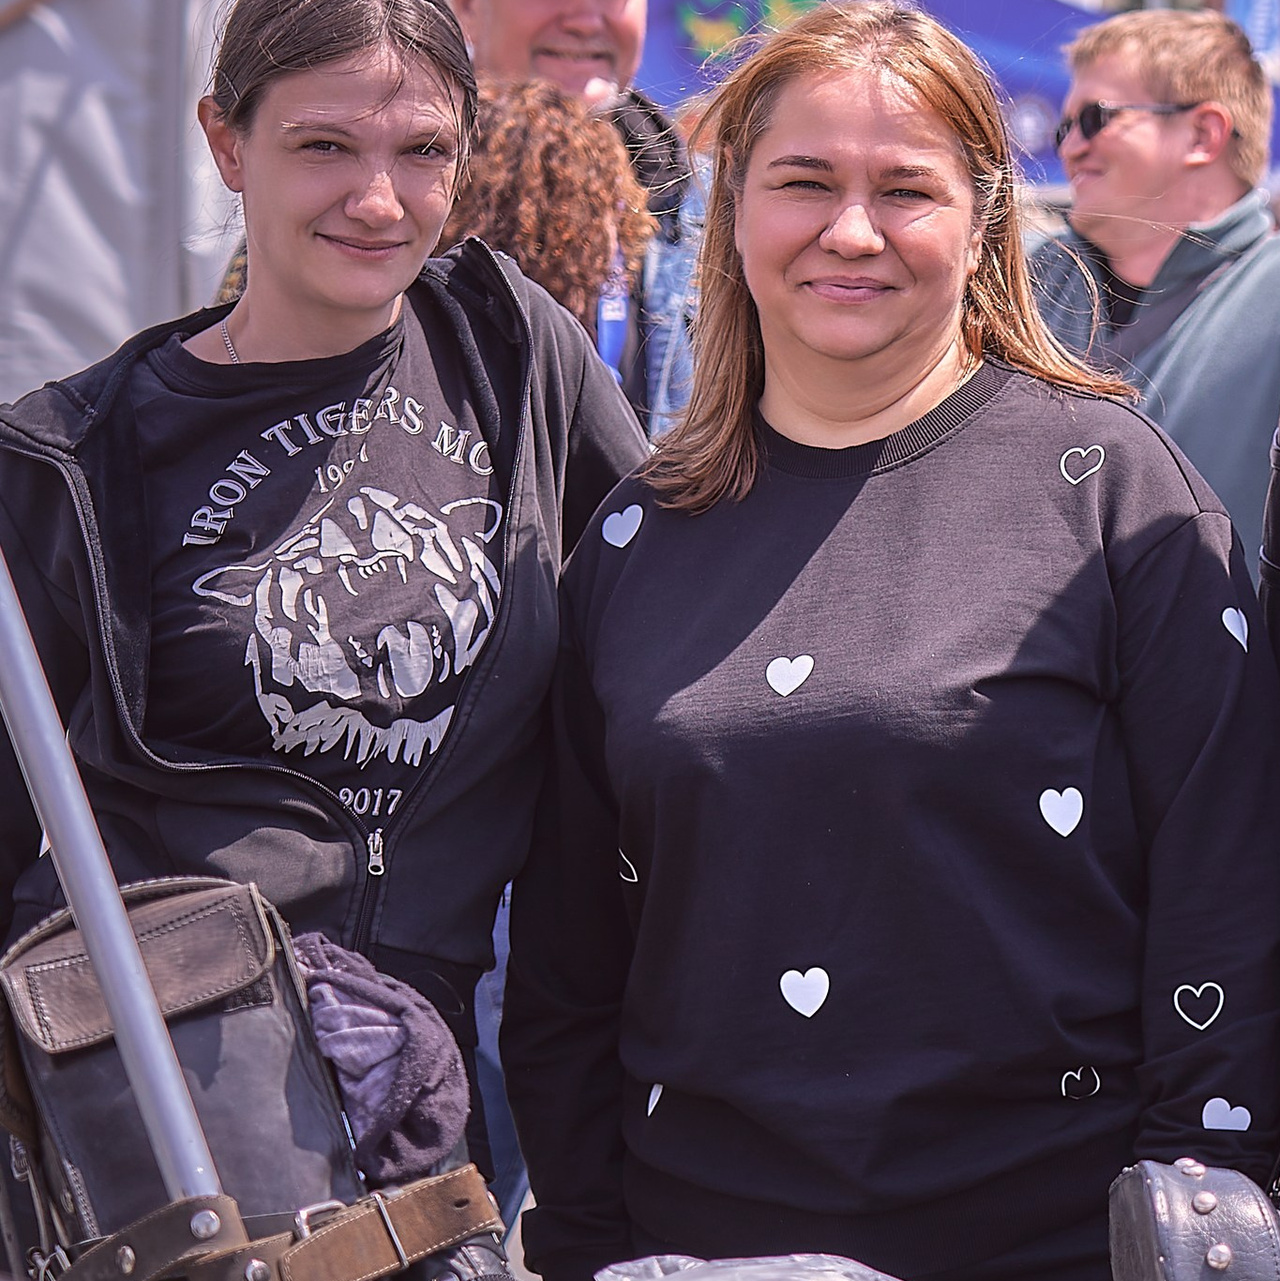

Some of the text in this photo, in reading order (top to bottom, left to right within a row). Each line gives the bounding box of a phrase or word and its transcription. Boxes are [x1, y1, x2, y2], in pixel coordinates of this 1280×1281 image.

[182, 386, 495, 547] IRON TIGERS MC
[339, 787, 403, 816] 2017
